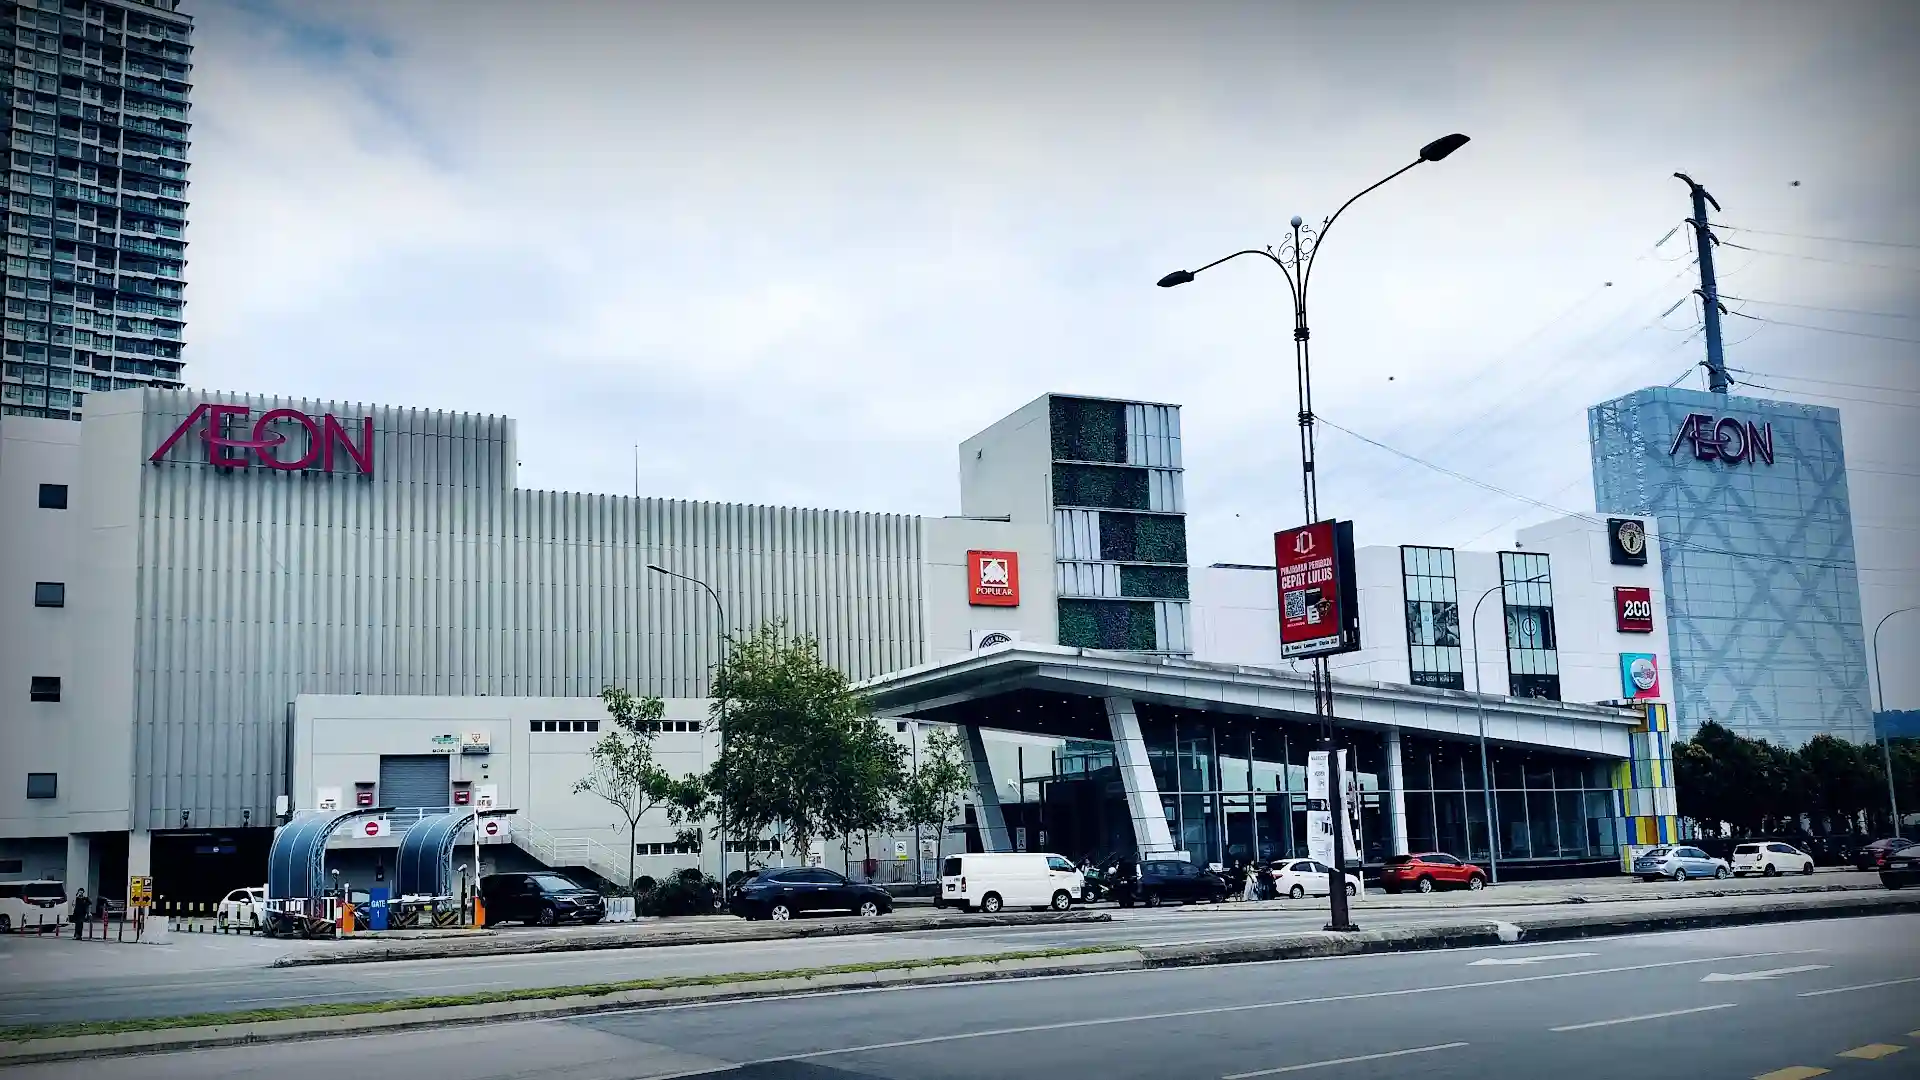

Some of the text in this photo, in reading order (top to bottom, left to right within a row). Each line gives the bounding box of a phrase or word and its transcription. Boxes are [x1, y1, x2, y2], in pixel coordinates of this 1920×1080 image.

[1281, 568, 1333, 590] CEPAT LULUS
[976, 587, 1013, 596] POPULAR
[371, 900, 385, 908] GATE
